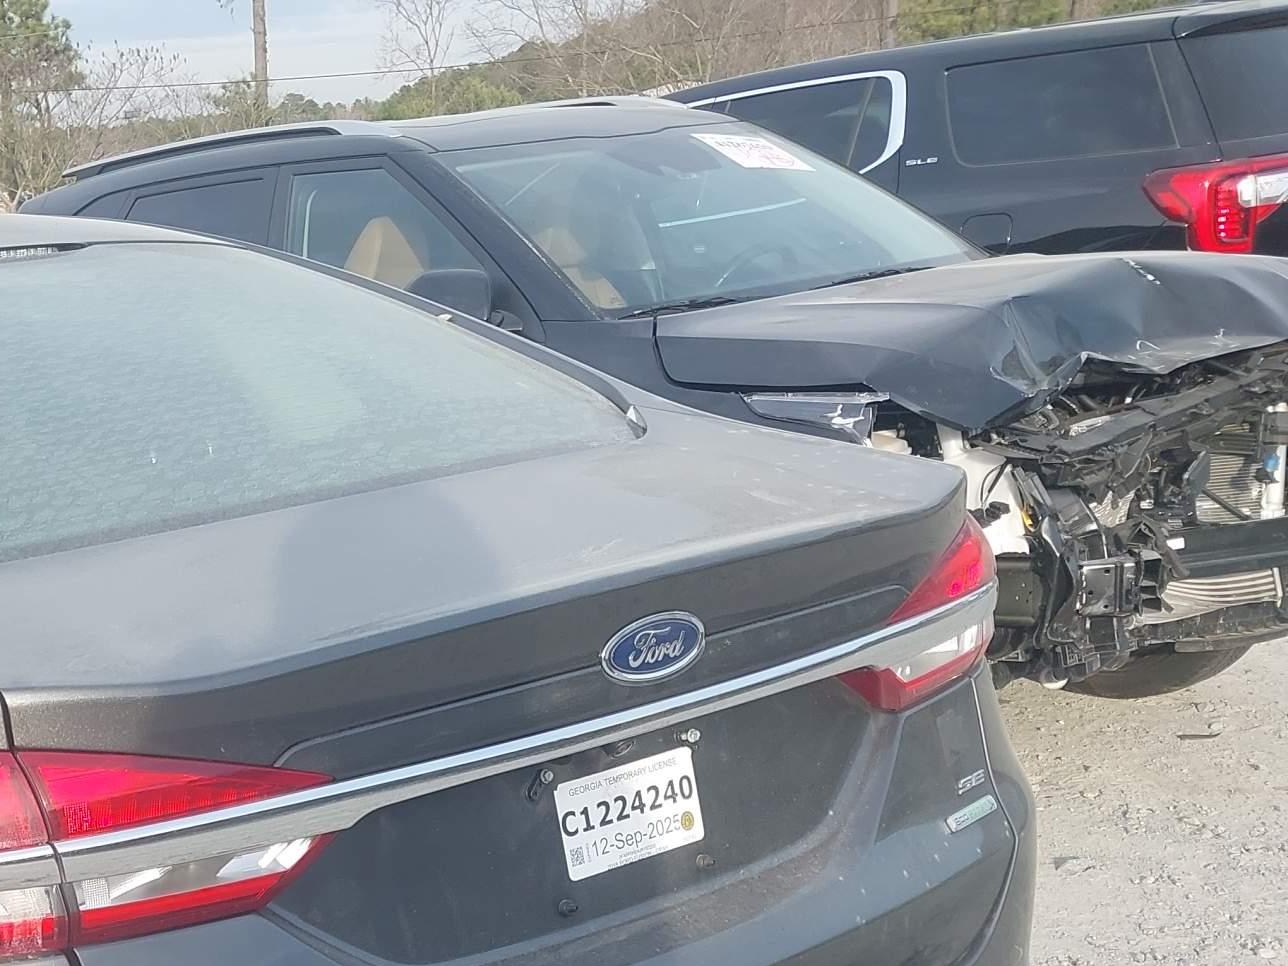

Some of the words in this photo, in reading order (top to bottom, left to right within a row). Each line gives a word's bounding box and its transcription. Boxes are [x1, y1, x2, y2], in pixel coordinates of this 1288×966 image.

[628, 626, 686, 668] Ford
[568, 780, 603, 796] GEORGIA
[604, 767, 647, 786] TEMPORARY
[648, 757, 677, 773] LICENSE
[958, 768, 986, 795] SE
[561, 774, 694, 837] C1224240
[591, 813, 682, 858] 12-Sep-2025
